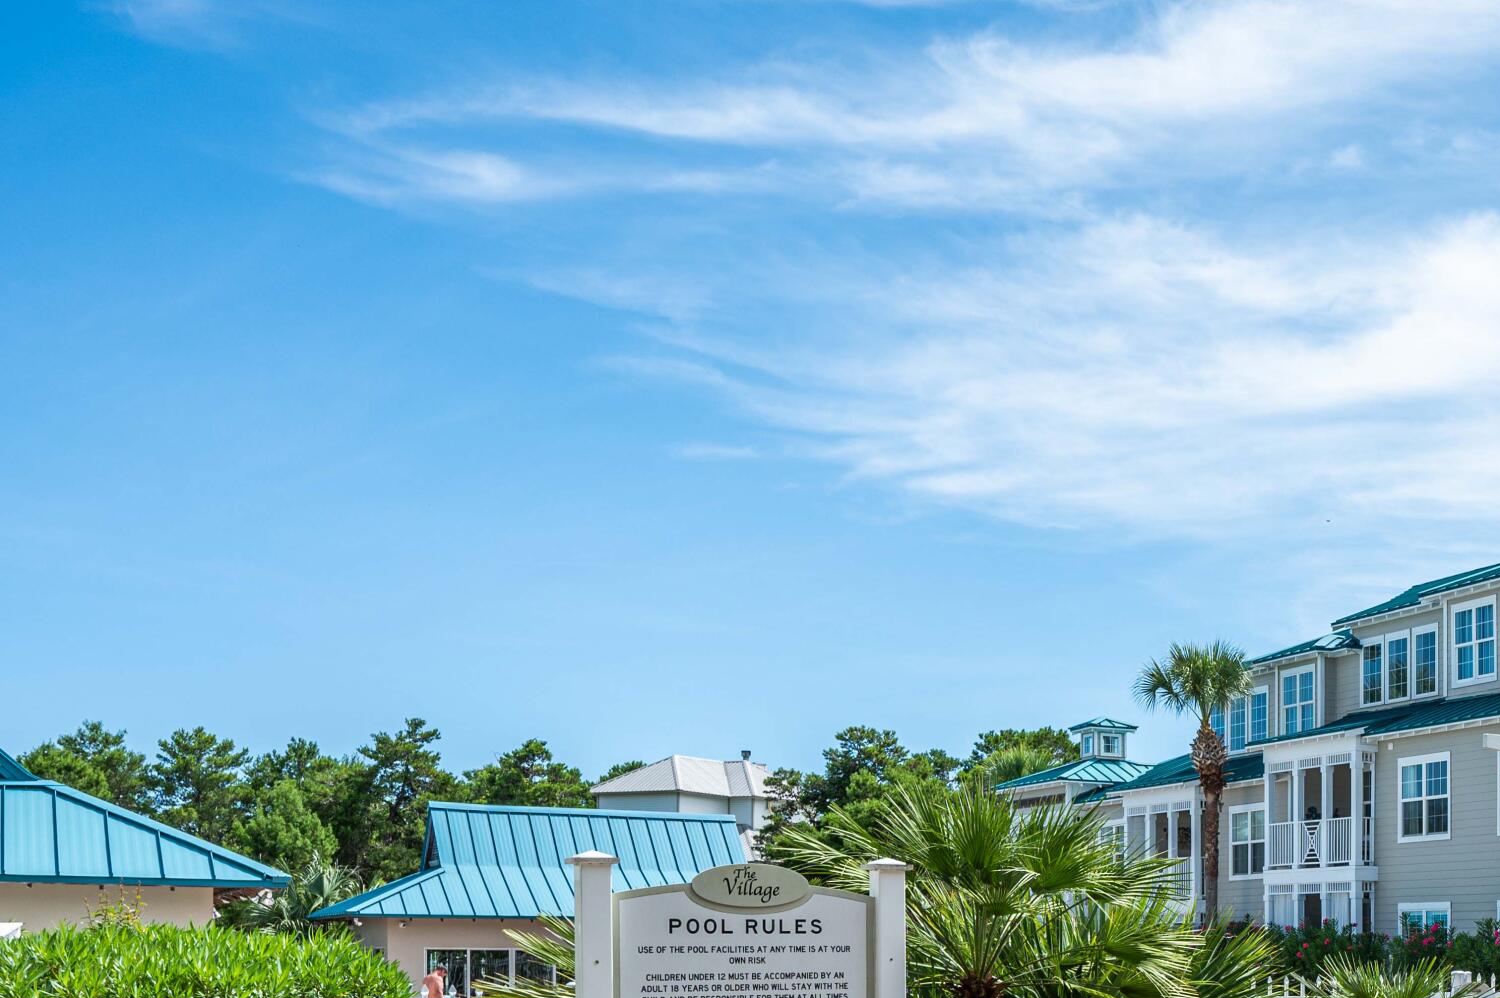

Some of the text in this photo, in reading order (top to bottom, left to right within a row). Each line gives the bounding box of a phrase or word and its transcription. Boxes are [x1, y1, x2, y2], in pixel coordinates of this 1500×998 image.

[733, 866, 756, 879] The
[722, 877, 780, 903] Village
[669, 919, 822, 934] POOL RULES
[638, 946, 654, 954] USE
[656, 946, 667, 954] OF
[670, 946, 685, 954] THE
[688, 946, 709, 954] POOL
[711, 946, 755, 954] FACILITIES
[646, 974, 687, 982] CHILDREN
[688, 973, 715, 981] UNDER
[718, 973, 726, 981] 12
[728, 973, 749, 981] MUST
[752, 973, 762, 981] BE
[764, 972, 819, 980] ACCOMPANIED
[641, 985, 668, 993] ADULT
[671, 985, 680, 993] 18
[711, 984, 722, 992] OR
[724, 984, 750, 992] OLDER
[791, 983, 812, 991] STAY
[834, 982, 849, 990] THE
